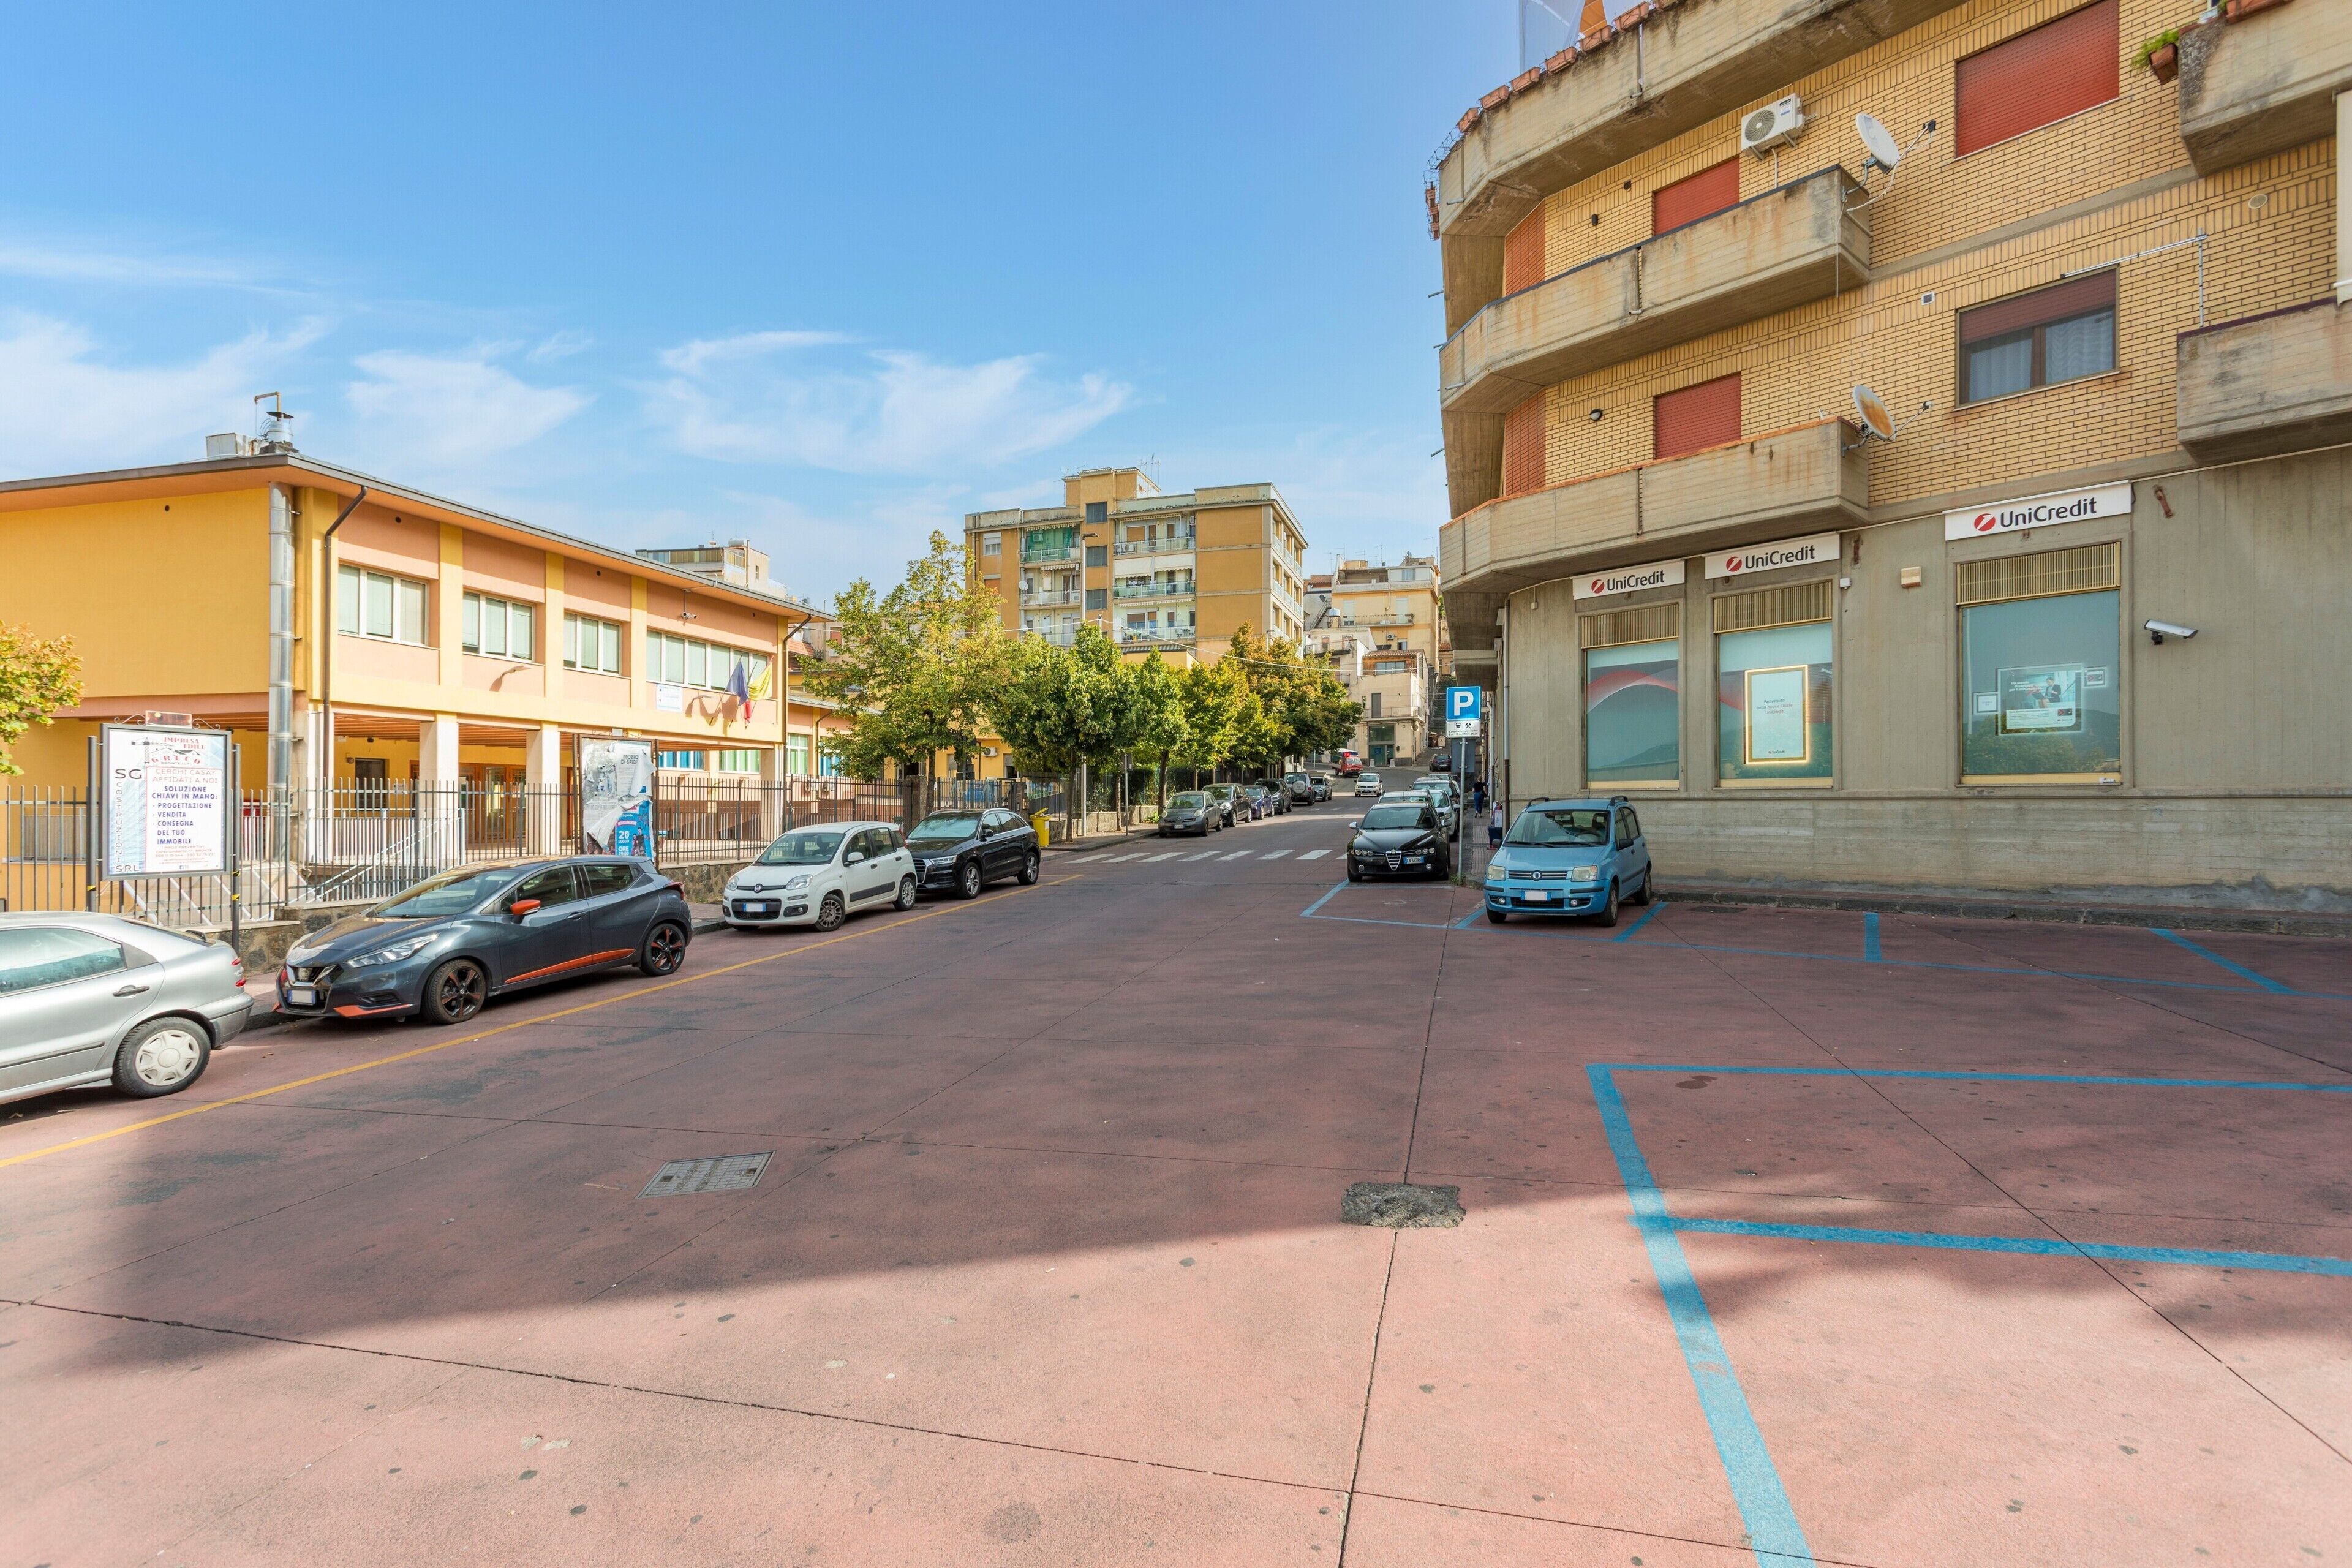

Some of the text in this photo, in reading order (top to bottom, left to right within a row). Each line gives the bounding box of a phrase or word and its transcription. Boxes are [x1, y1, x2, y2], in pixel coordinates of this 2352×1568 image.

[2000, 497, 2097, 527] UniCredit
[1745, 545, 1815, 569] UniCredit
[1607, 570, 1664, 591] UniCredit
[1454, 691, 1474, 716] P
[151, 755, 201, 765] GRECO
[115, 768, 142, 780] SG
[618, 830, 630, 839] 20
